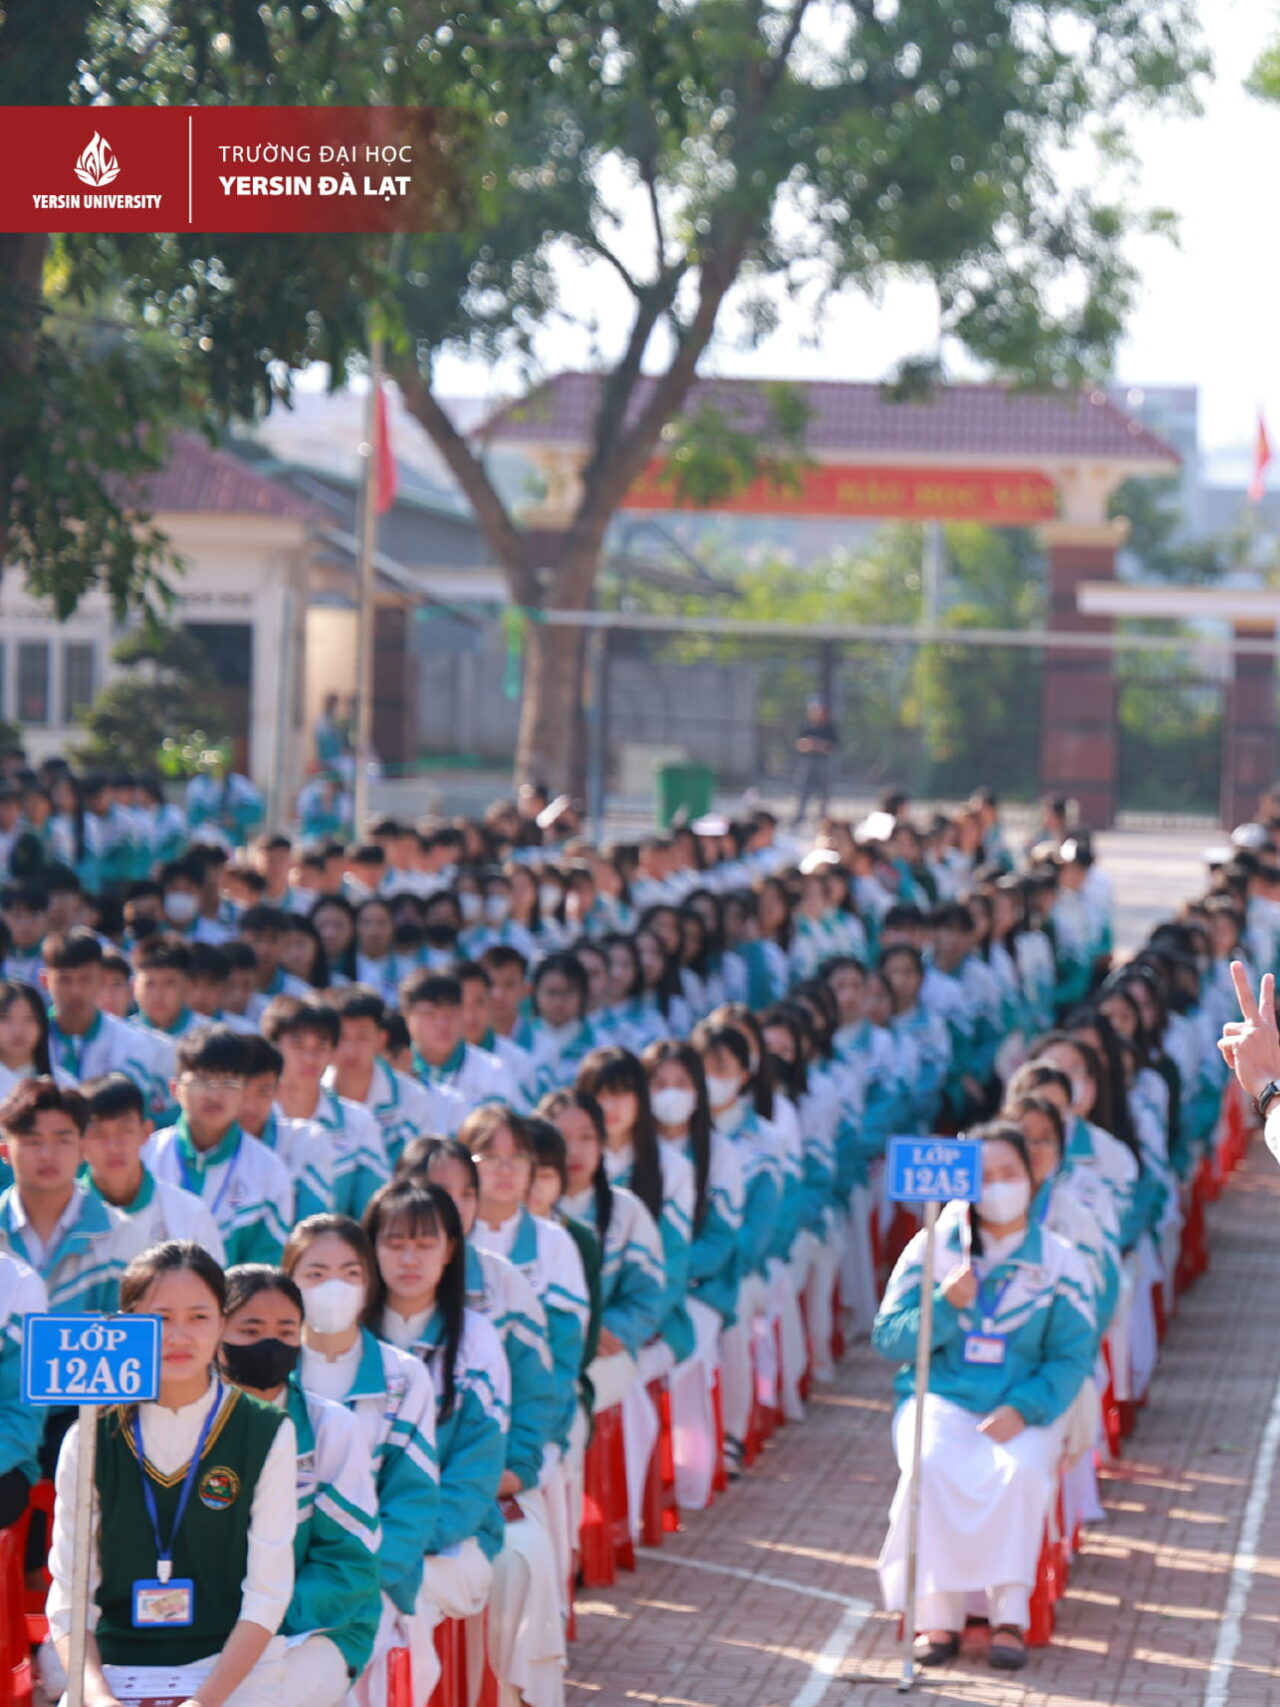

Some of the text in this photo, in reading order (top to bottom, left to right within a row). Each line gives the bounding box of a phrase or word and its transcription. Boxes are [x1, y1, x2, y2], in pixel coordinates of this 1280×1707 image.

[903, 1167, 970, 1195] 12A5
[58, 1322, 128, 1351] LỚP
[45, 1356, 142, 1395] 12A6
